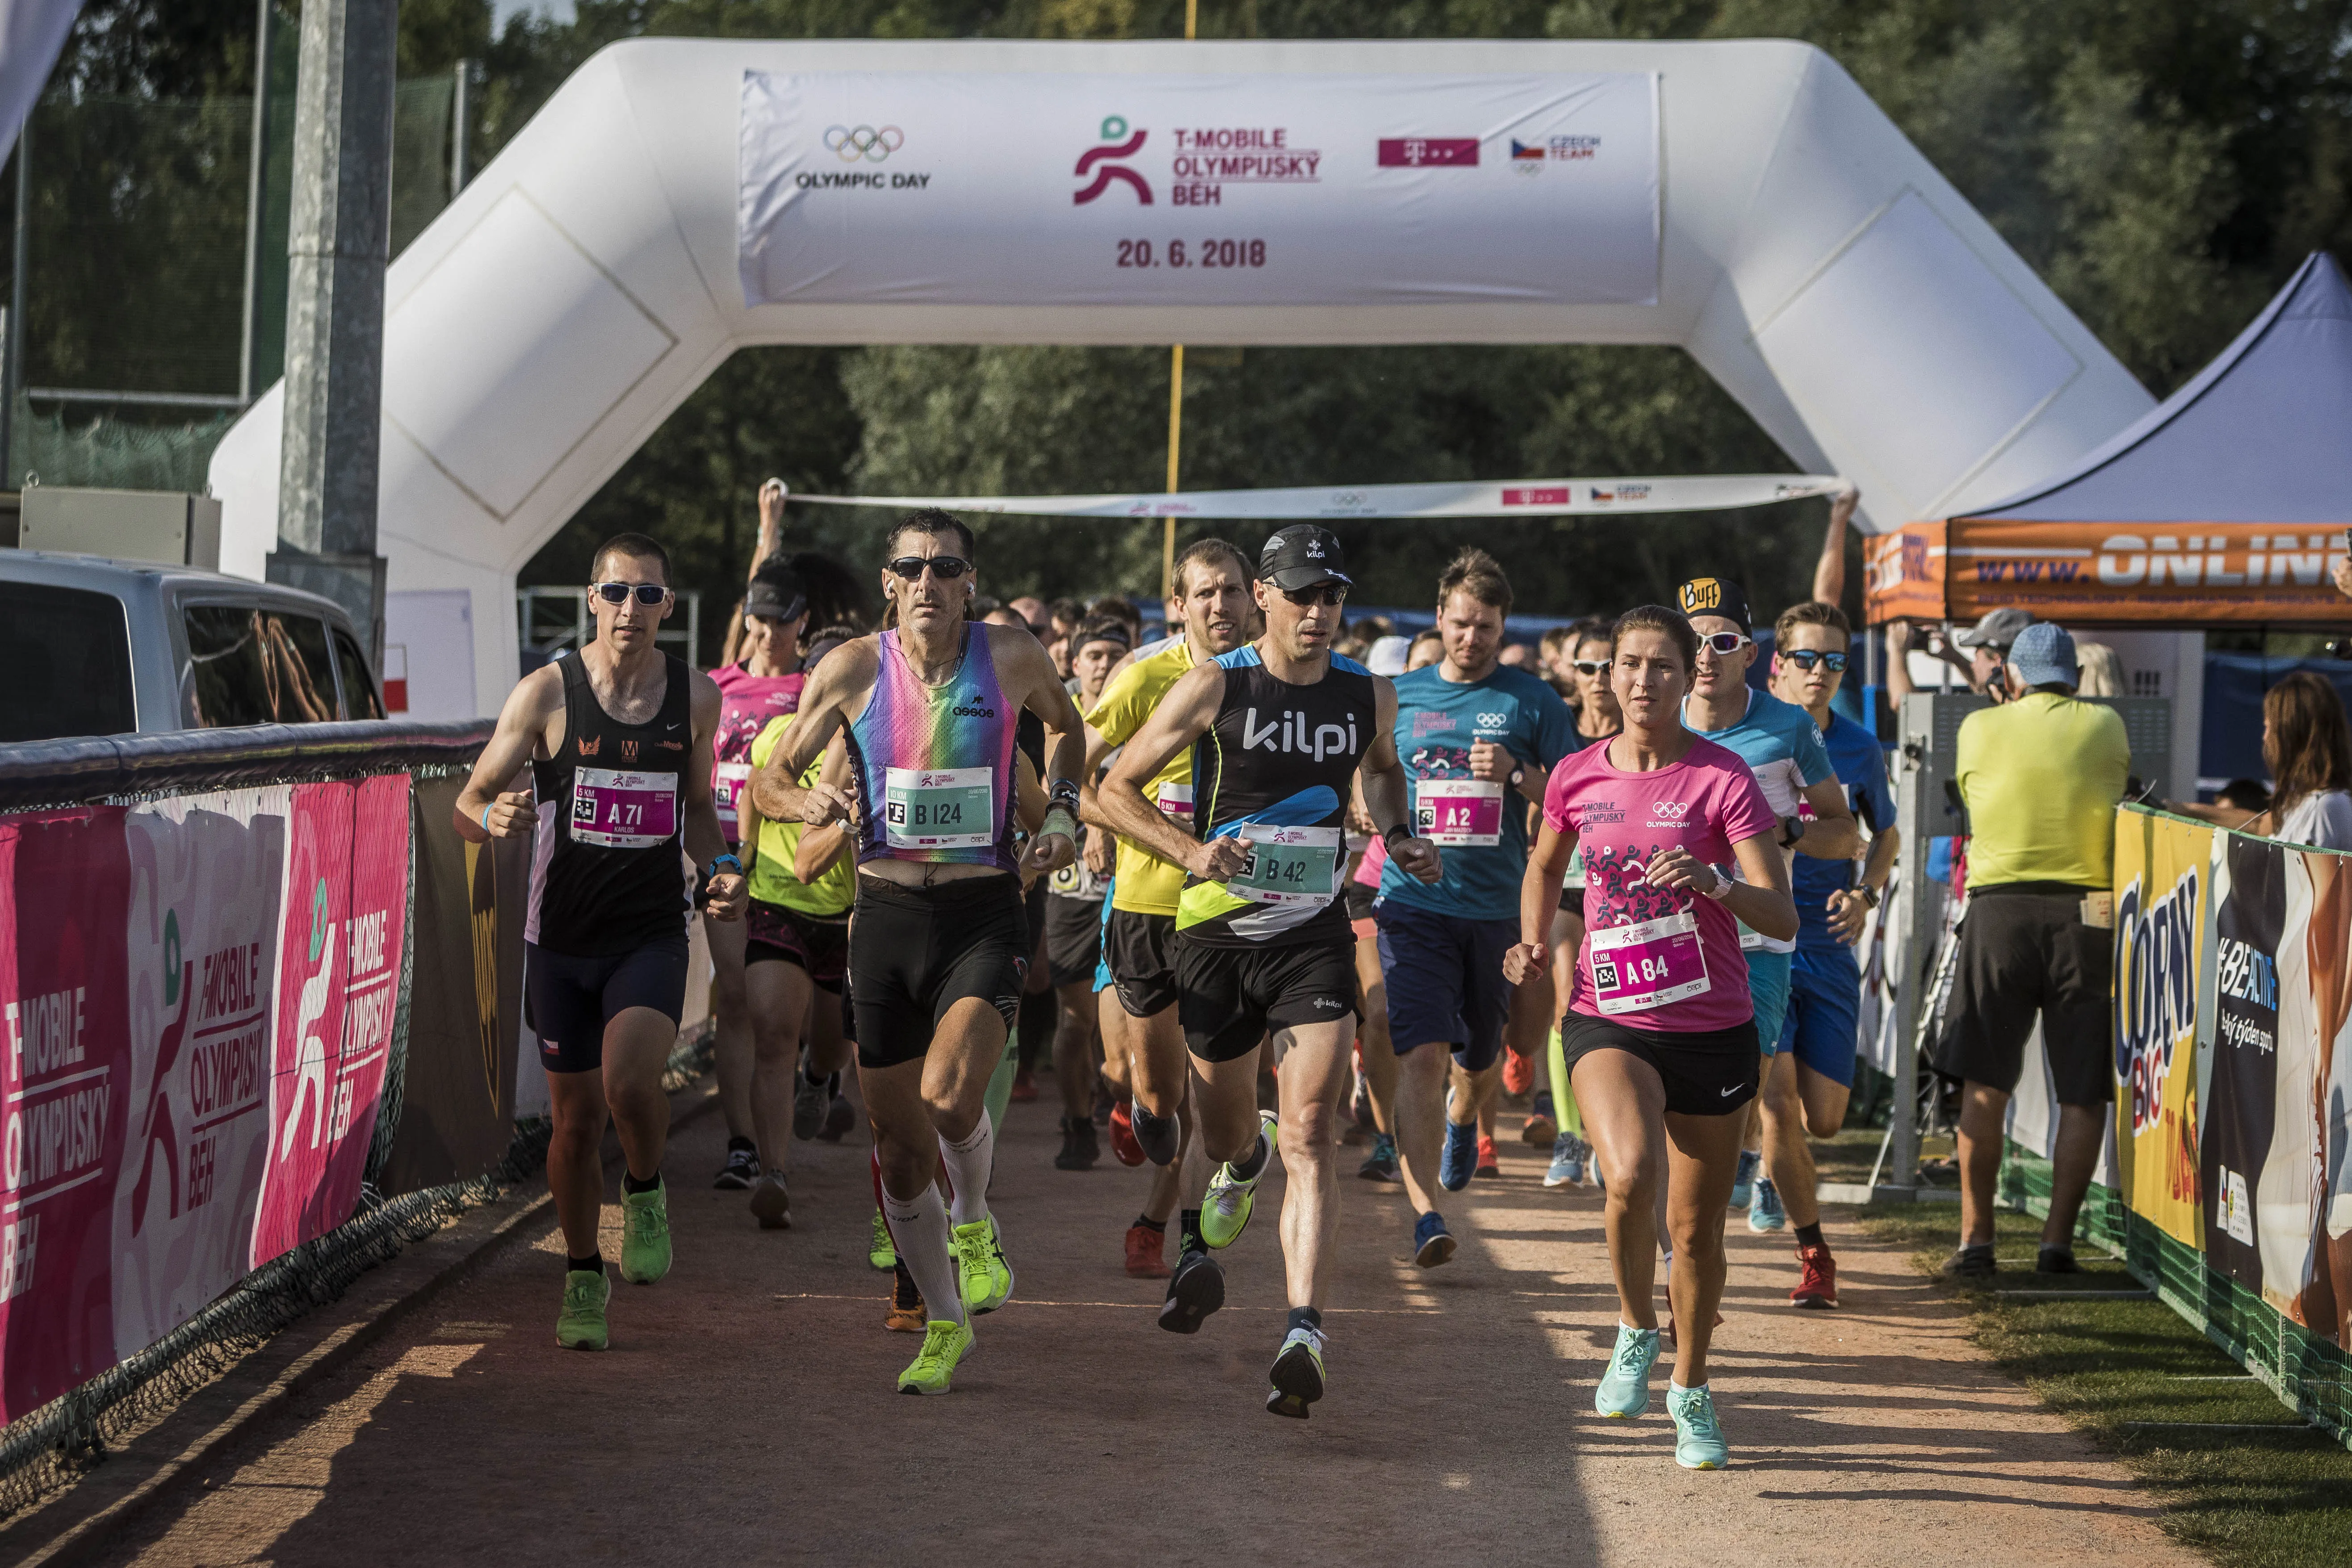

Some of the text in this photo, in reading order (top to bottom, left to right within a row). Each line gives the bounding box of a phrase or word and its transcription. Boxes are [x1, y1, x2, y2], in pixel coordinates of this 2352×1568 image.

[1174, 129, 1287, 149] T-MOBILE
[1549, 148, 1596, 161] TEAM
[796, 172, 931, 189] OLYMPIC DAY
[1117, 239, 1267, 268] 20. 6. 2018
[1307, 550, 1325, 558] kilpi
[952, 706, 994, 718] assos
[1243, 708, 1357, 762] kilpi
[584, 789, 595, 798] KM
[890, 790, 907, 800] 10 KM
[608, 803, 642, 825] A 71
[915, 803, 962, 825] B 124
[1161, 801, 1176, 812] 5 KM
[1582, 802, 1615, 811] T-MOBILE
[1446, 807, 1471, 826] A 2
[614, 826, 634, 834] KARLOS
[1266, 859, 1306, 883] B 42
[346, 910, 386, 978] T-MOBILE
[1672, 934, 1694, 943] 20/06/2018
[1595, 952, 1610, 963] 5 KM
[1626, 955, 1669, 985] A 84
[2115, 871, 2197, 1078] CORNY
[197, 943, 260, 1023] T-MOBILE
[1326, 1000, 1342, 1008] kilpi
[5, 986, 86, 1082] T-MOBILE
[2235, 1018, 2260, 1048] týden
